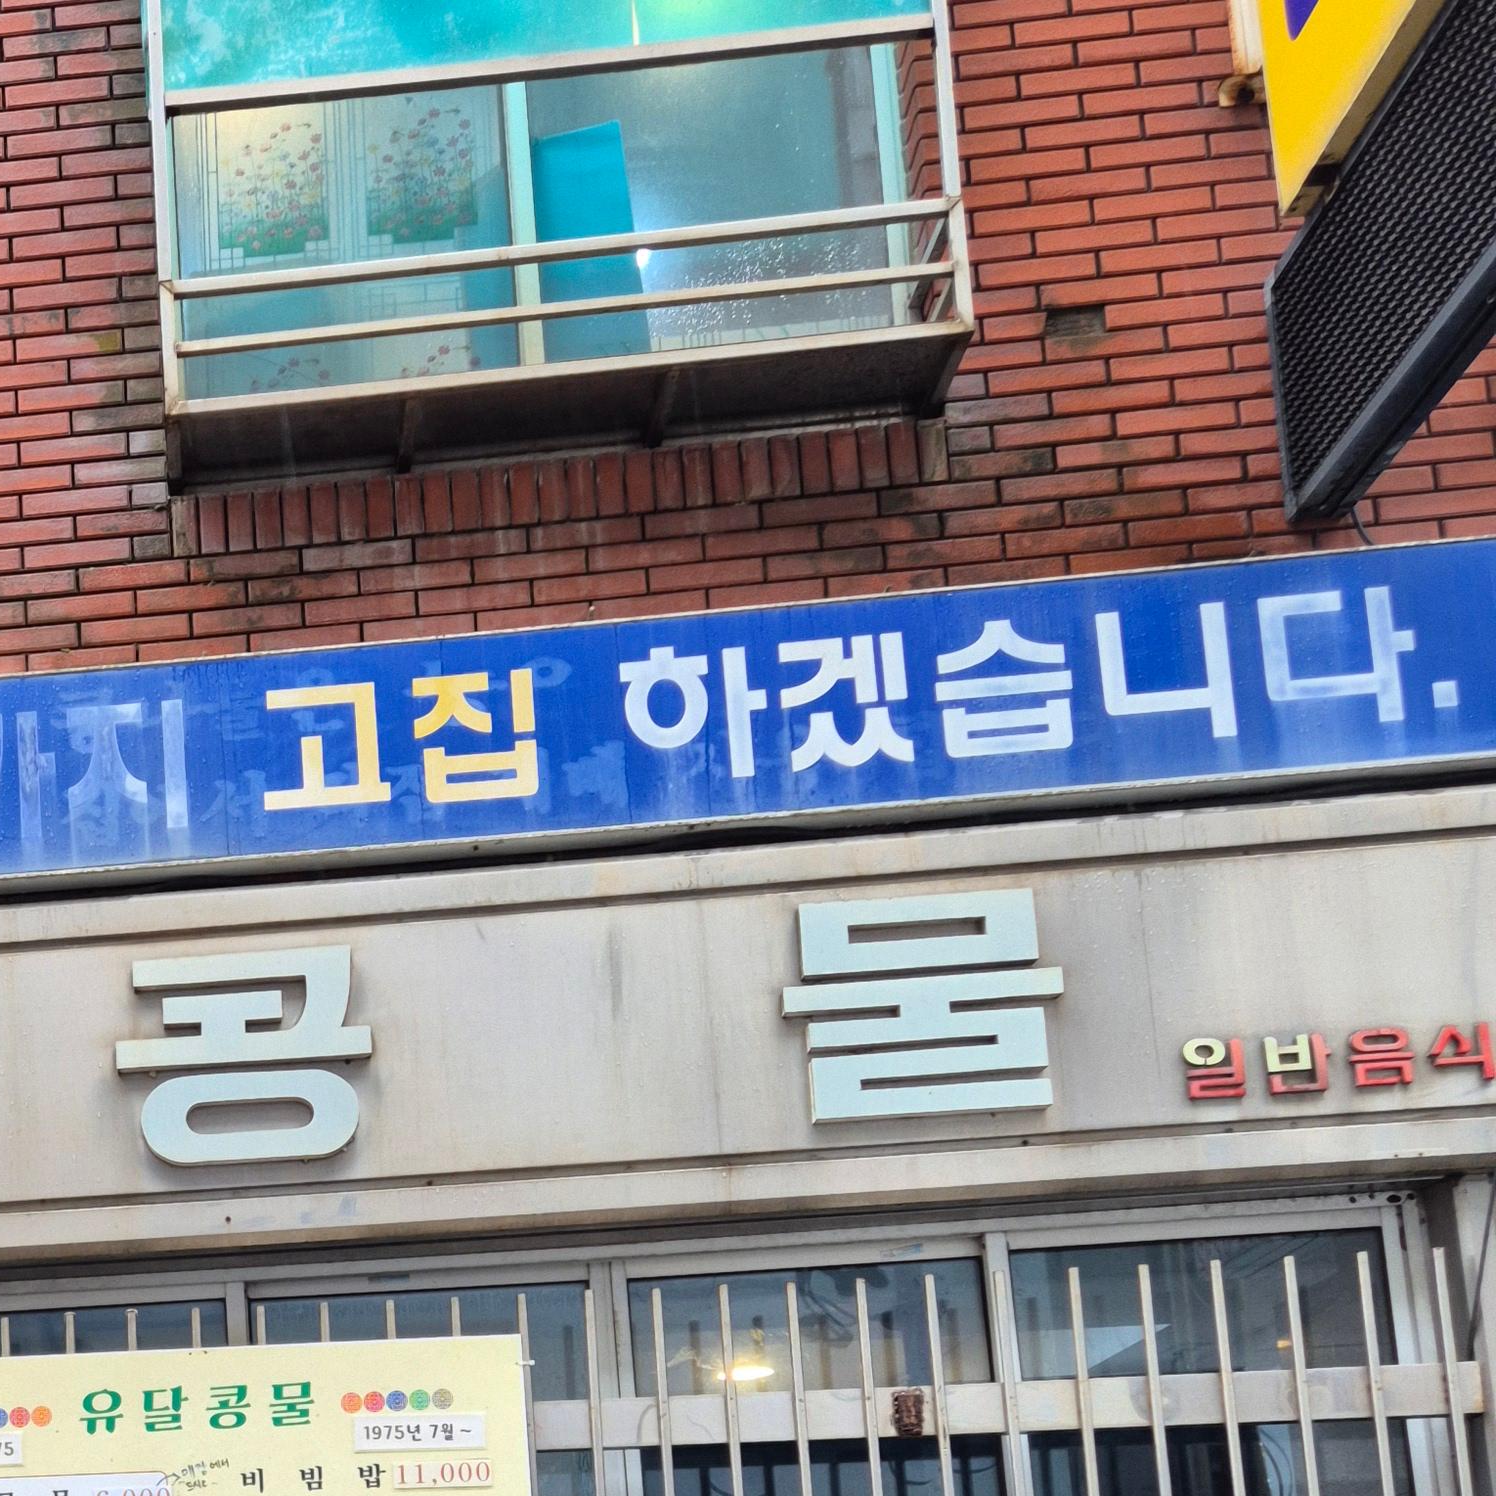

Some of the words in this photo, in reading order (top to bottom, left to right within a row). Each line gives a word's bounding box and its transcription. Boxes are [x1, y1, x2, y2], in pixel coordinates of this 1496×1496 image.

[264, 668, 539, 810] 고집
[619, 586, 1459, 778] 하겠습니다.
[79, 1381, 315, 1435] 유달콩물
[363, 1424, 422, 1442] 1975년
[431, 1423, 454, 1440] 7월
[240, 1463, 386, 1493] 비빔밥
[397, 1461, 491, 1486] 11,000
